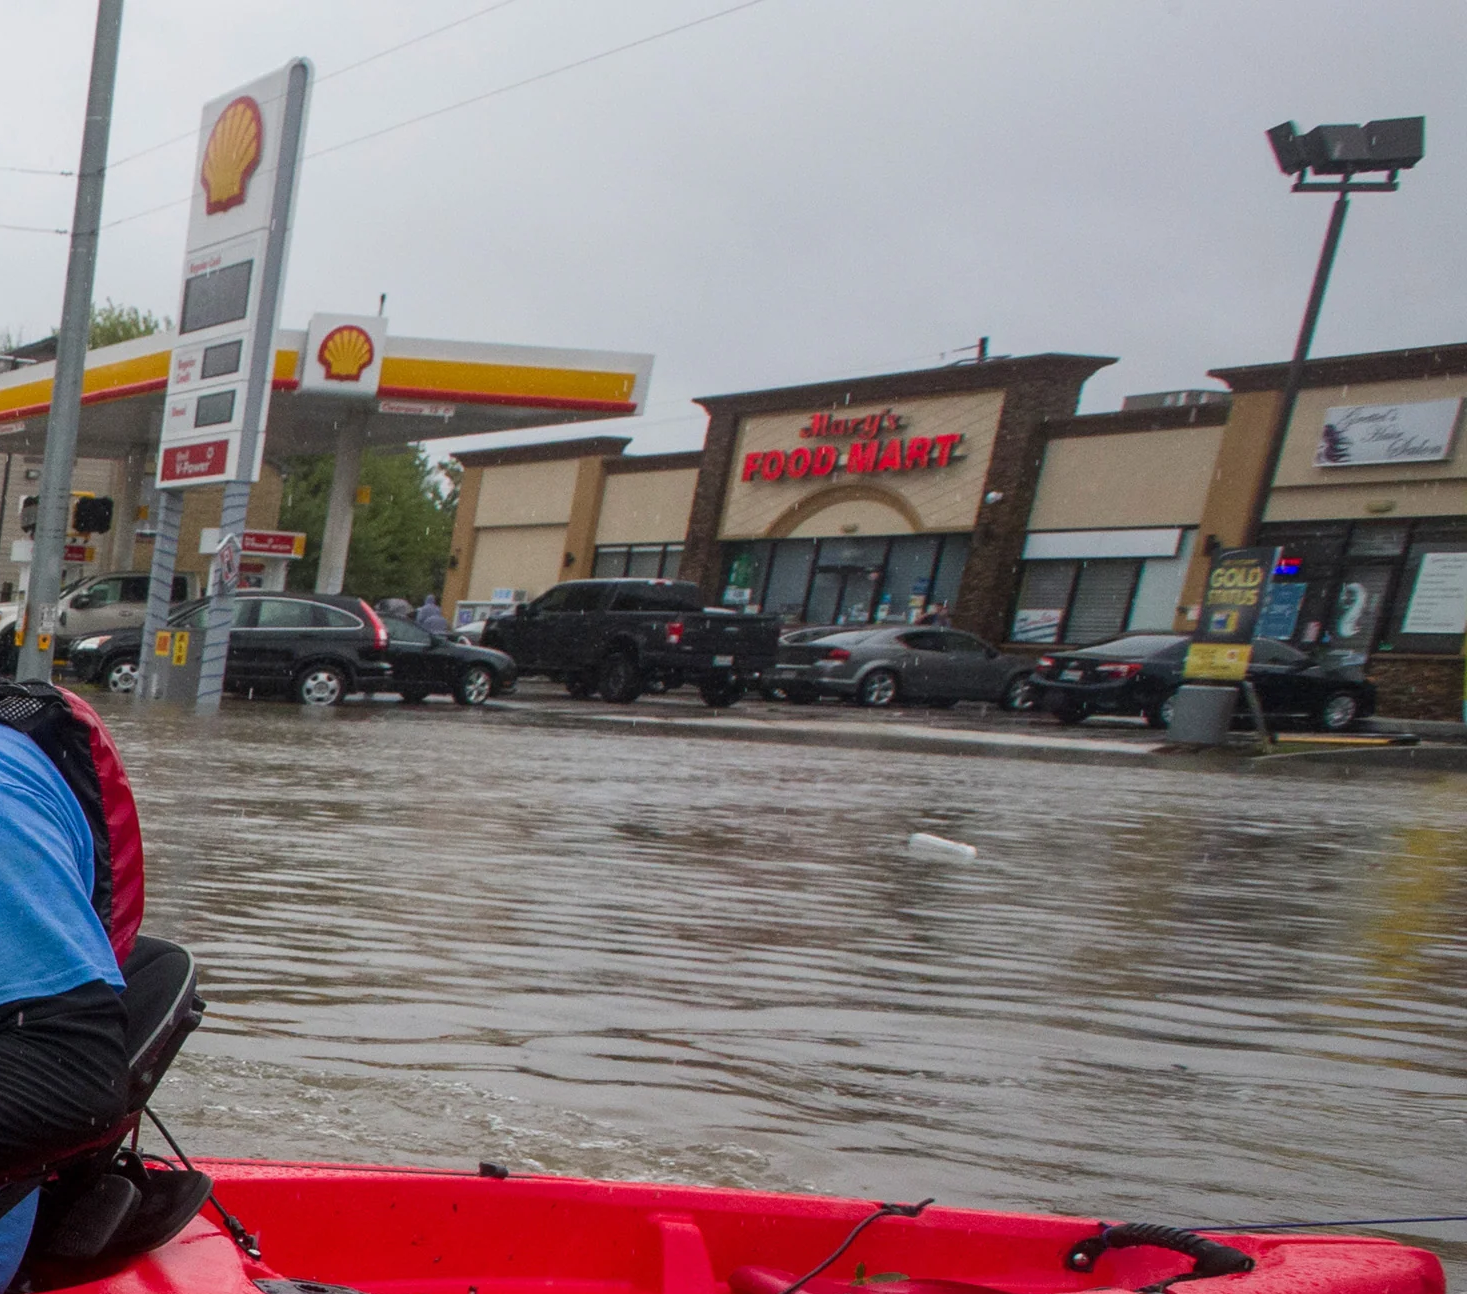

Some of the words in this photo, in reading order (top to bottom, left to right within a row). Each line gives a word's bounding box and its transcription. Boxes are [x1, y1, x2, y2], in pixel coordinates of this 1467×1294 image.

[799, 408, 900, 440] Mary's
[741, 445, 838, 482] FOOD
[847, 433, 961, 473] MART
[1210, 566, 1265, 588] GOLD
